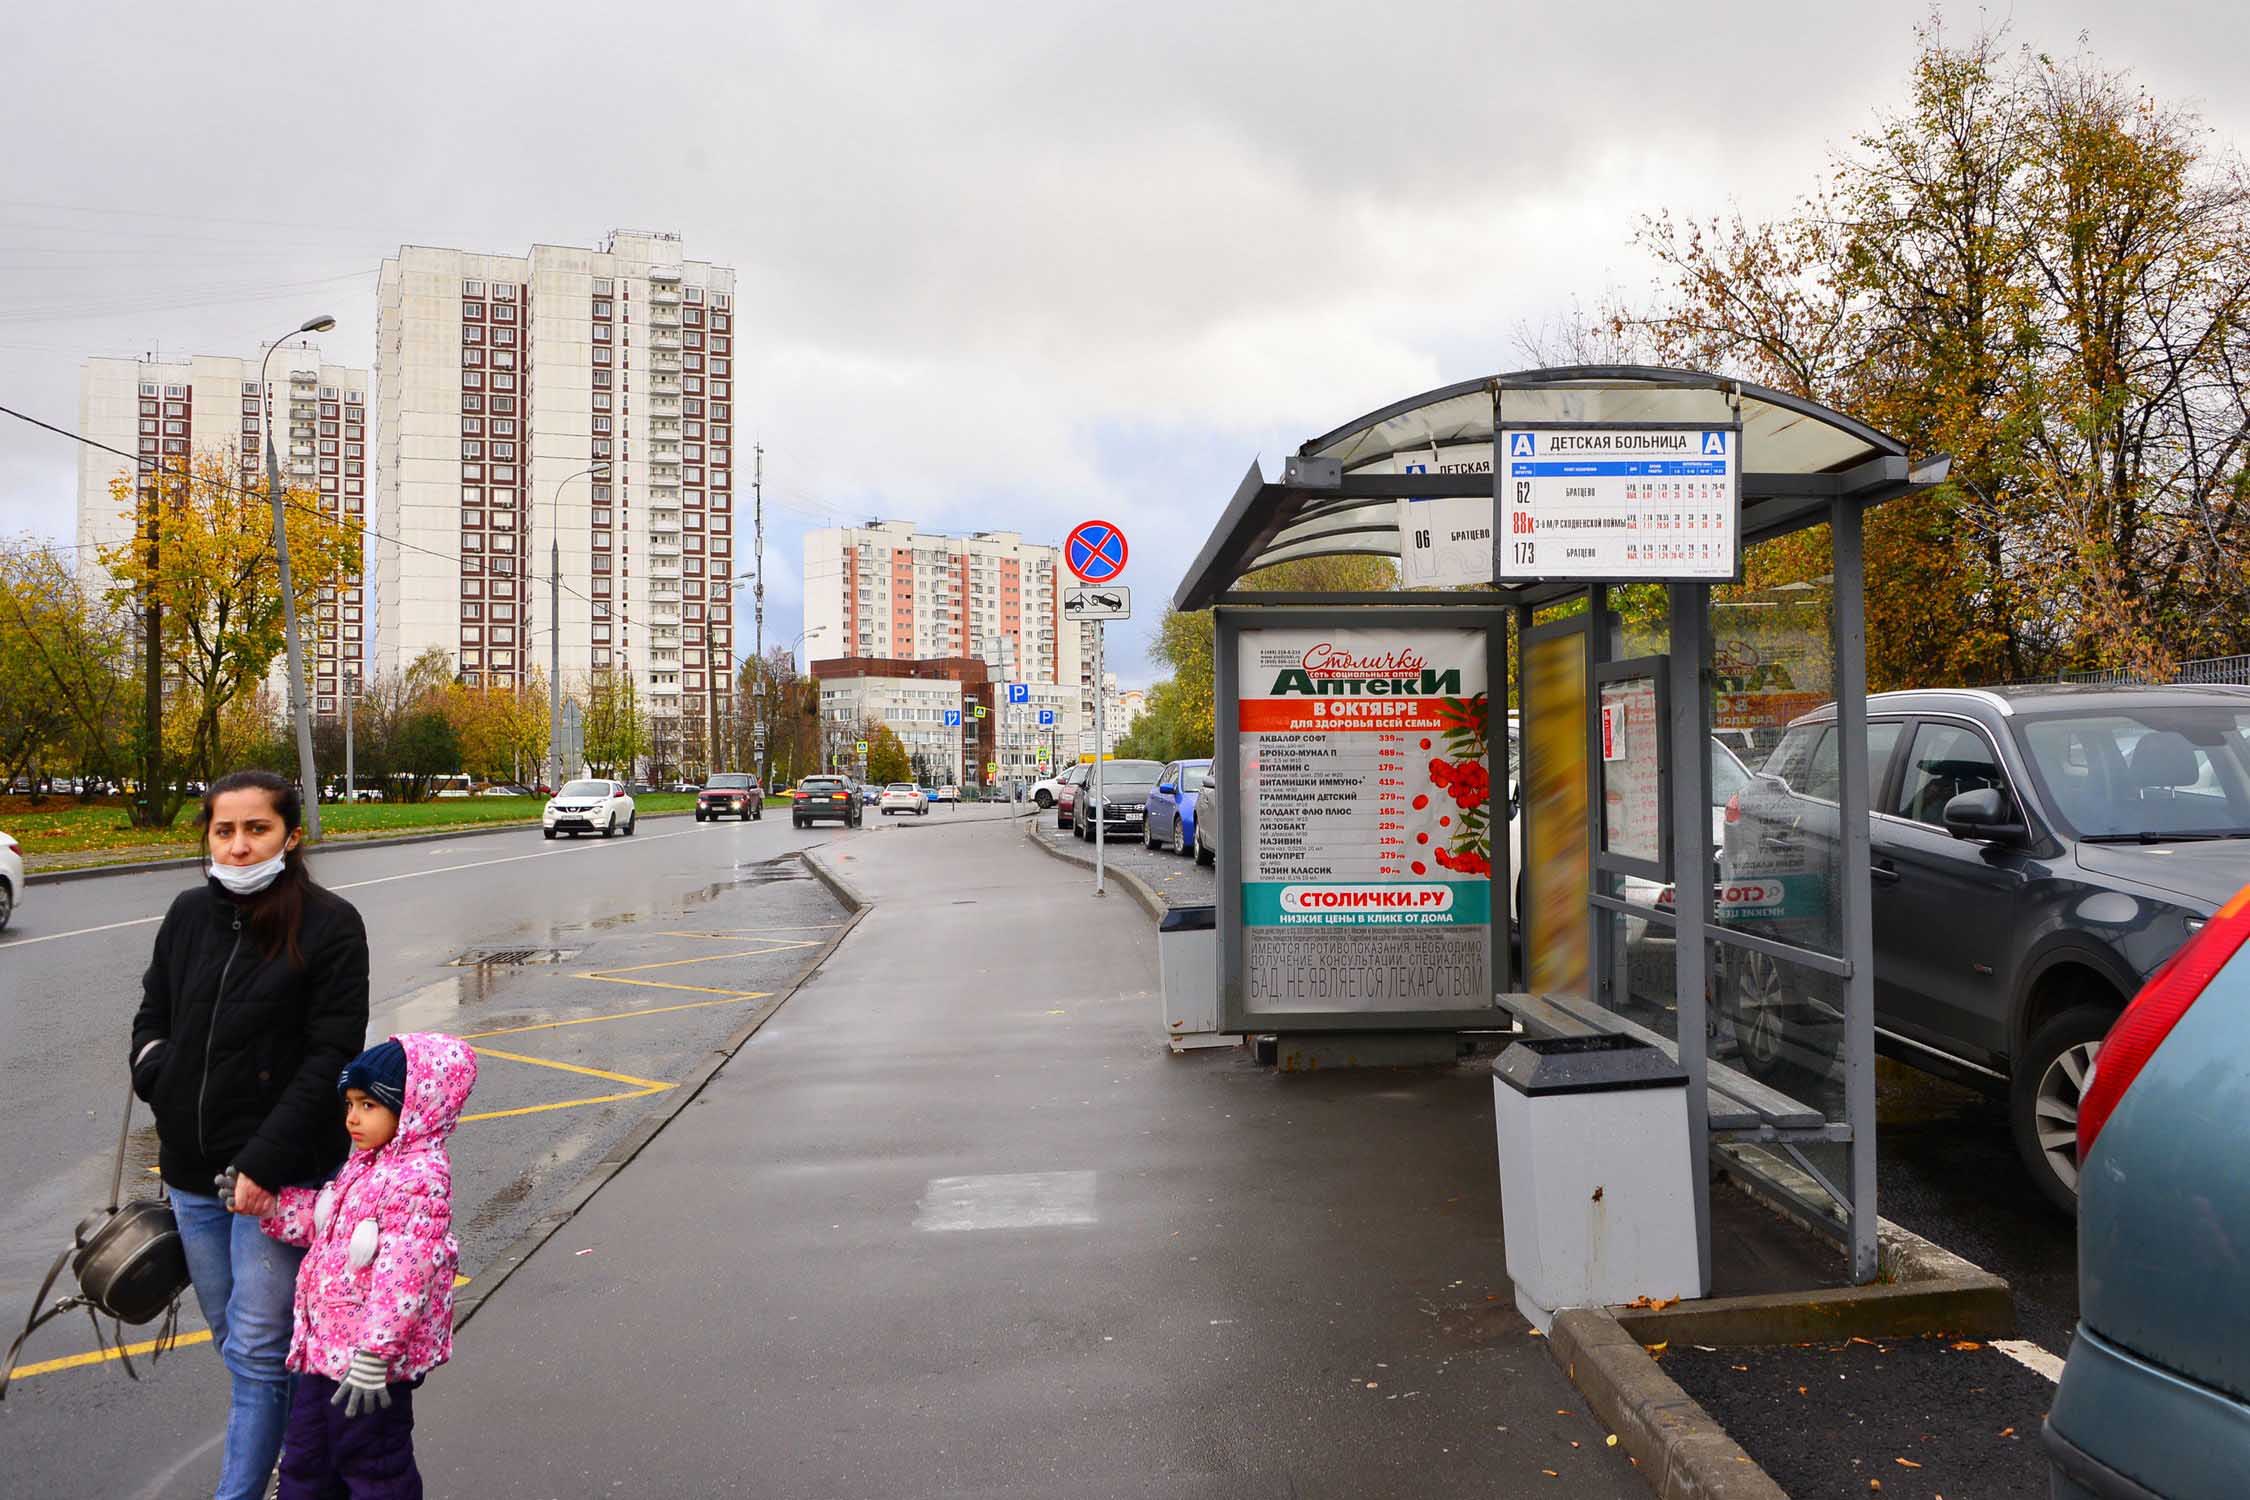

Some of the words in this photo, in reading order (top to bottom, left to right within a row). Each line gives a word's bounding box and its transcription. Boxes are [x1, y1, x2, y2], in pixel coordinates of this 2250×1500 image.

[1550, 436, 1611, 451] ДЕТСКАЯ
[1615, 435, 1687, 450] БОЛЬНИЦА
[1516, 481, 1531, 503] 62
[1566, 487, 1596, 498] БРАТЦЕВО
[1602, 517, 1626, 528] ПОЙМЫ
[1451, 528, 1490, 542] БРАТЦЕВО
[1514, 542, 1535, 565] 173
[1566, 547, 1596, 558] БРАТЦЕВО
[1302, 643, 1428, 670] Столички
[1331, 671, 1389, 679] социальных
[1014, 686, 1025, 702] P
[1314, 702, 1326, 716] В
[1330, 702, 1418, 716] ОКТЯБРЕ
[1043, 711, 1051, 723] P
[1290, 719, 1312, 729] ДЛЯ
[1315, 719, 1373, 729] ЗДОРОВЬЯ
[1375, 717, 1402, 728] ВСЕЙ
[1405, 719, 1441, 728] СЕМЬИ
[1260, 749, 1329, 757] БРОНХО-МУНАЛ
[1260, 778, 1317, 786] ВИТАМИШКИ
[1260, 793, 1316, 802] ГРАММИДИН
[1317, 792, 1357, 802] ДЕТСКИЙ
[1260, 808, 1300, 816] КОЛДАКТ
[1259, 823, 1306, 831] ЛИЗОБАКТ
[1260, 852, 1305, 860] СИНУПРЕТ
[1300, 892, 1445, 907] СТОЛИЧКИ.РУ
[1279, 914, 1322, 923] НИЗКИЕ
[1325, 914, 1355, 924] ЦЕНЫ
[1358, 914, 1365, 923] В
[1367, 914, 1402, 923] КЛИКЕ
[1405, 914, 1418, 922] ОТ
[1421, 913, 1453, 923] ДОМА
[1251, 942, 1300, 954] ИМЕЮТСЯ
[1415, 941, 1482, 953] НЕОБХОДИМО
[1251, 955, 1313, 966] ПОЛУЧЕНИЕ
[1320, 954, 1402, 966] КОНСУЛЬТАЦИИ
[1409, 953, 1482, 966] СПЕЦИАЛИСТА
[1287, 967, 1305, 998] НЕ
[1309, 967, 1383, 998] ЯВЛЯЕТСЯ
[1388, 966, 1482, 998] ЛЕКАРСТВОМ
